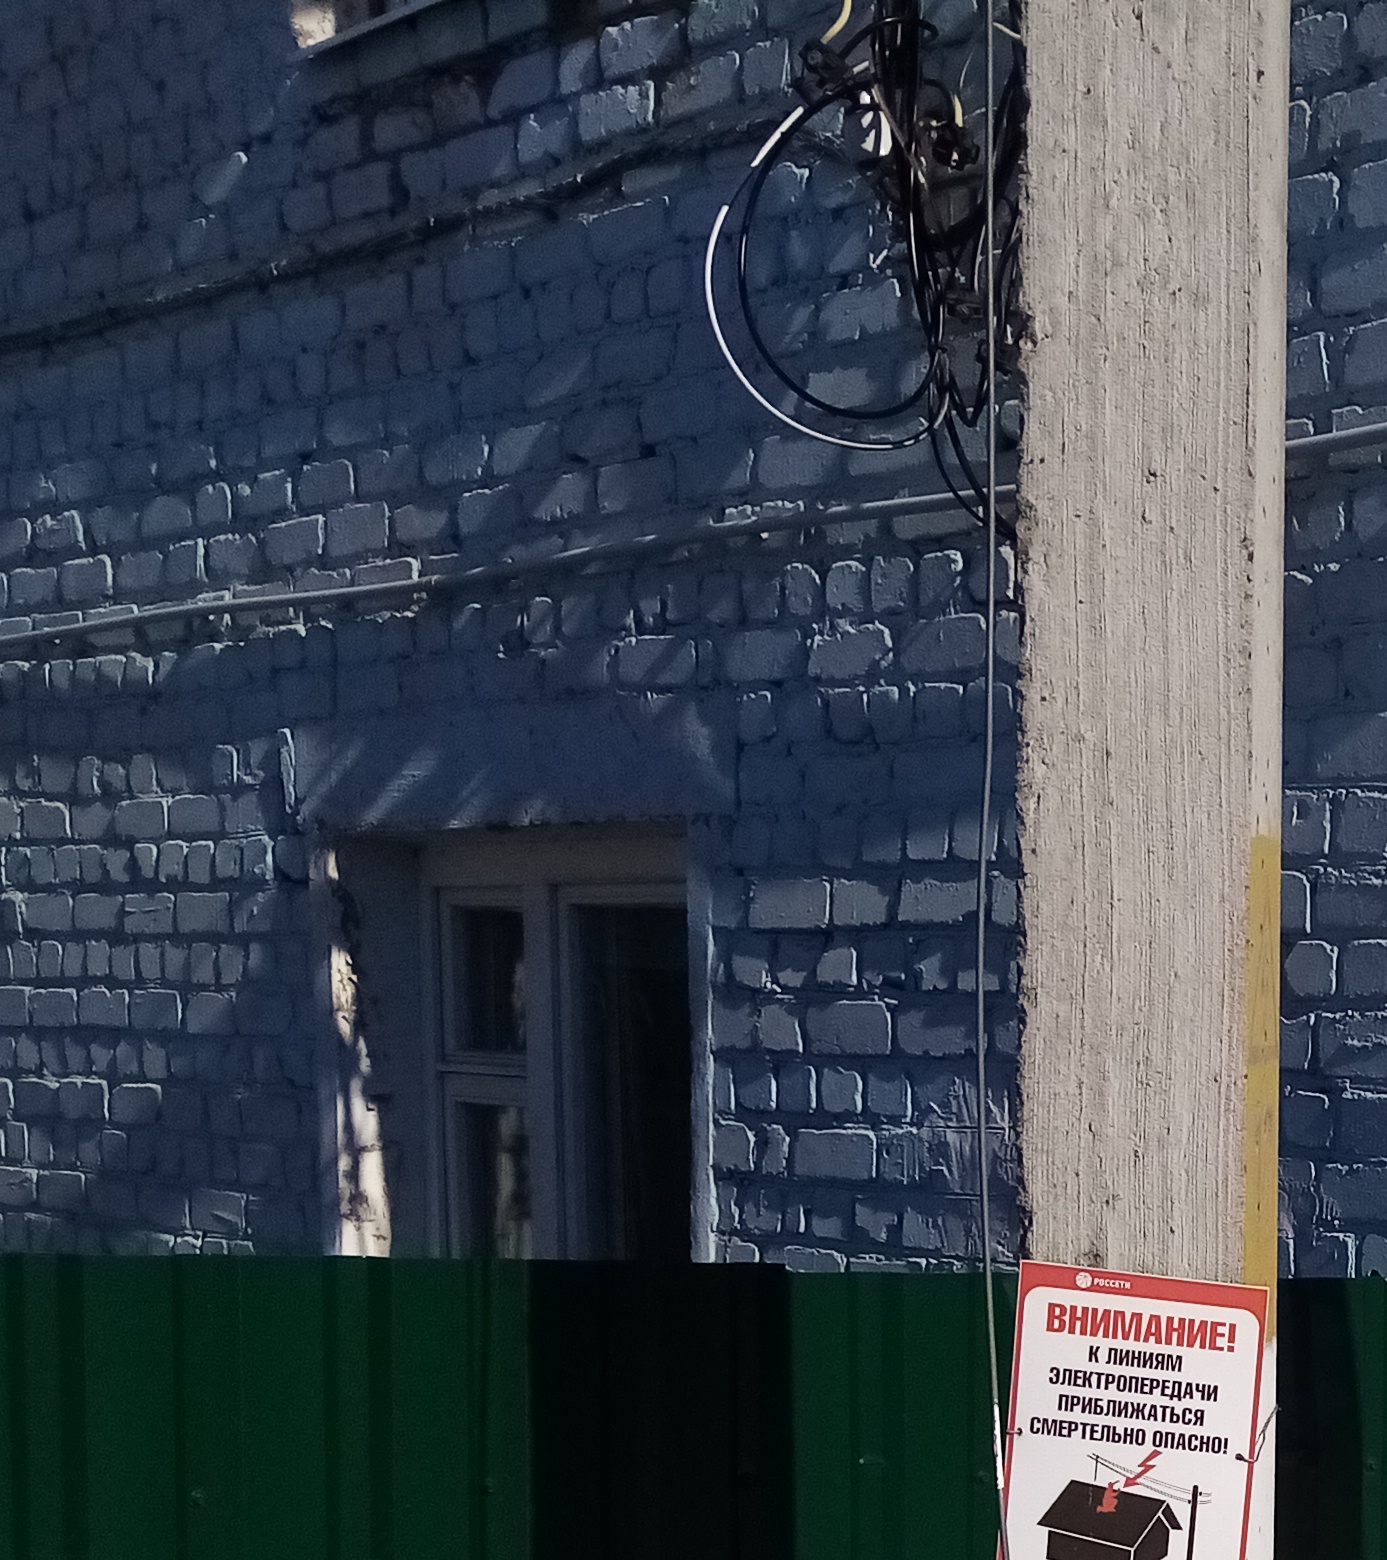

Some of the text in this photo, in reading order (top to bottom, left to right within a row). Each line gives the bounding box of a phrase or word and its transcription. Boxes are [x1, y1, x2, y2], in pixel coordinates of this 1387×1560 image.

[1093, 1277, 1131, 1290] РОССЕТИ
[1045, 1302, 1236, 1353] ВНИМАНИЕ!
[1088, 1345, 1183, 1373] К ЛИНИЯМ
[1048, 1367, 1219, 1402] ЭЛЕКТРОПЕРЕДАЧИ
[1057, 1394, 1205, 1427] ПРИБЛИЖАТЬСЯ
[1029, 1416, 1229, 1455] СМЕРТЕЛЬНО ОПАСНО!
